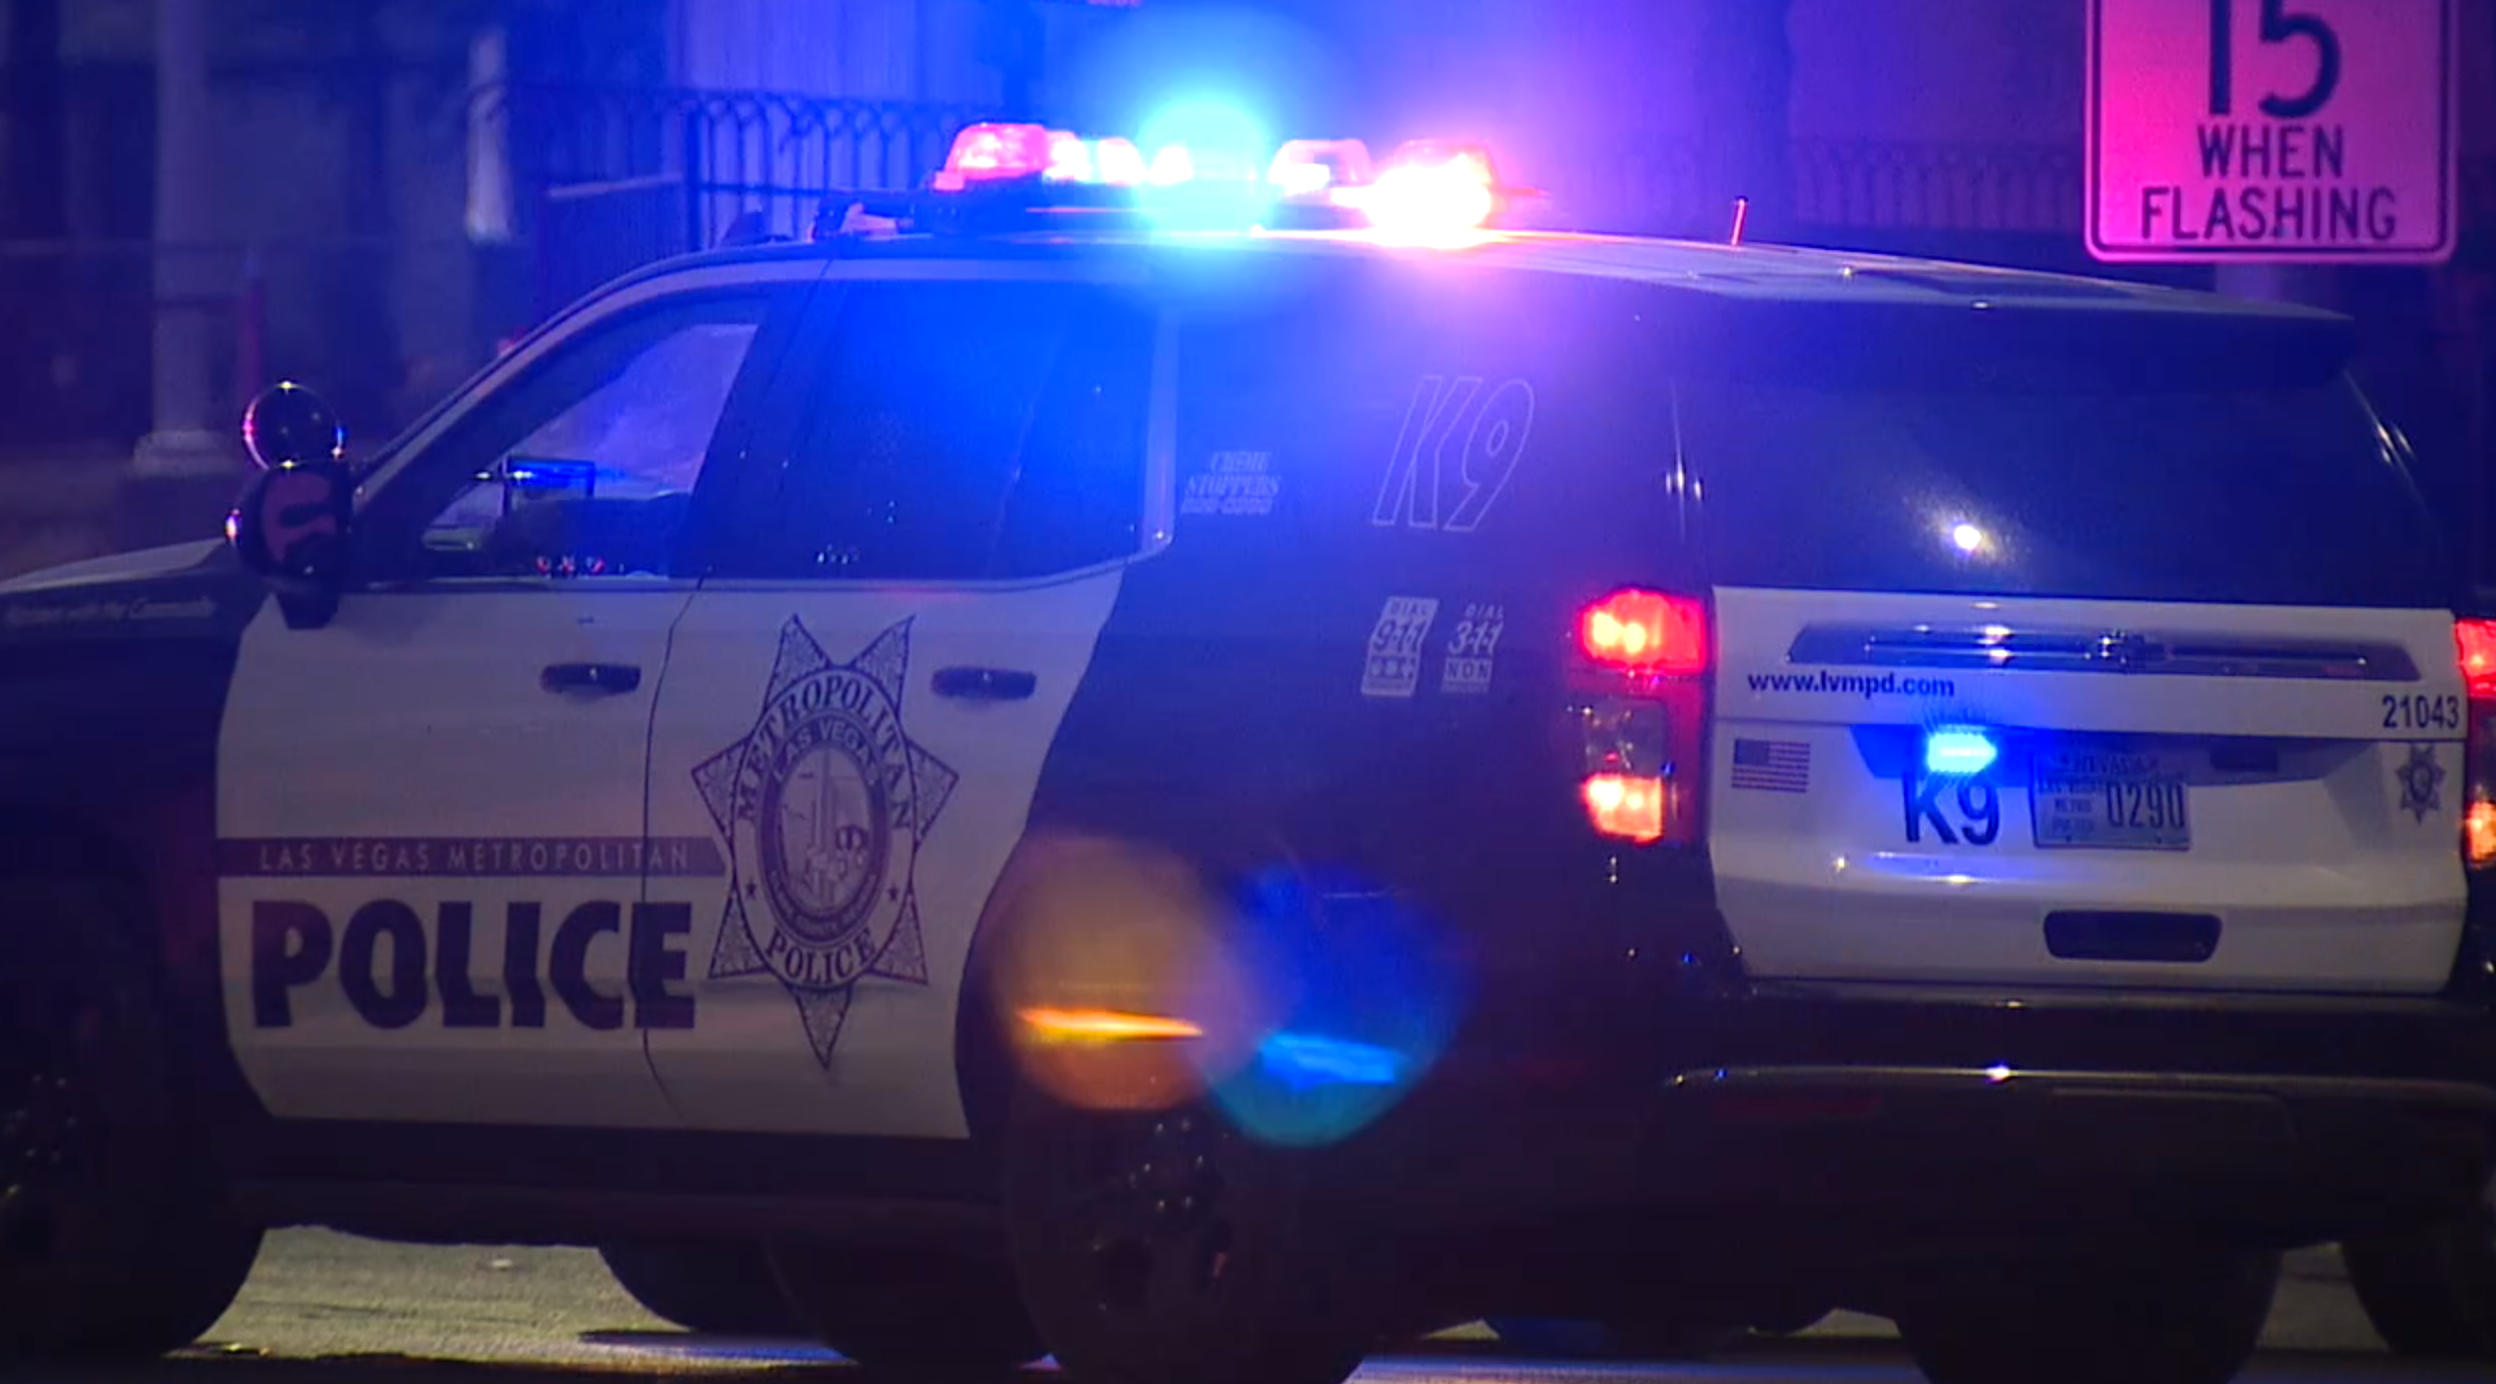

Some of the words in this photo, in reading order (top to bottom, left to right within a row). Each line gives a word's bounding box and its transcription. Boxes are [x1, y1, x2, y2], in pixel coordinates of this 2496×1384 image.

[2209, 0, 2342, 119] 15
[2197, 124, 2345, 179] WHEN
[2140, 186, 2398, 241] FLASHING
[1371, 374, 1536, 532] K9
[1464, 603, 1505, 618] DIAL
[1450, 661, 1488, 679] NON
[1748, 670, 1956, 700] www.lvmpd.com
[2382, 694, 2460, 729] 21043
[735, 674, 912, 829] METROPOLITAN
[1902, 766, 2000, 846] K9
[2106, 781, 2185, 830] 0290
[259, 843, 317, 871] LAS
[330, 843, 431, 871] VEGAS
[447, 842, 690, 871] METROPOLITAN
[250, 897, 697, 1031] POLICE
[766, 925, 878, 985] POLICE
